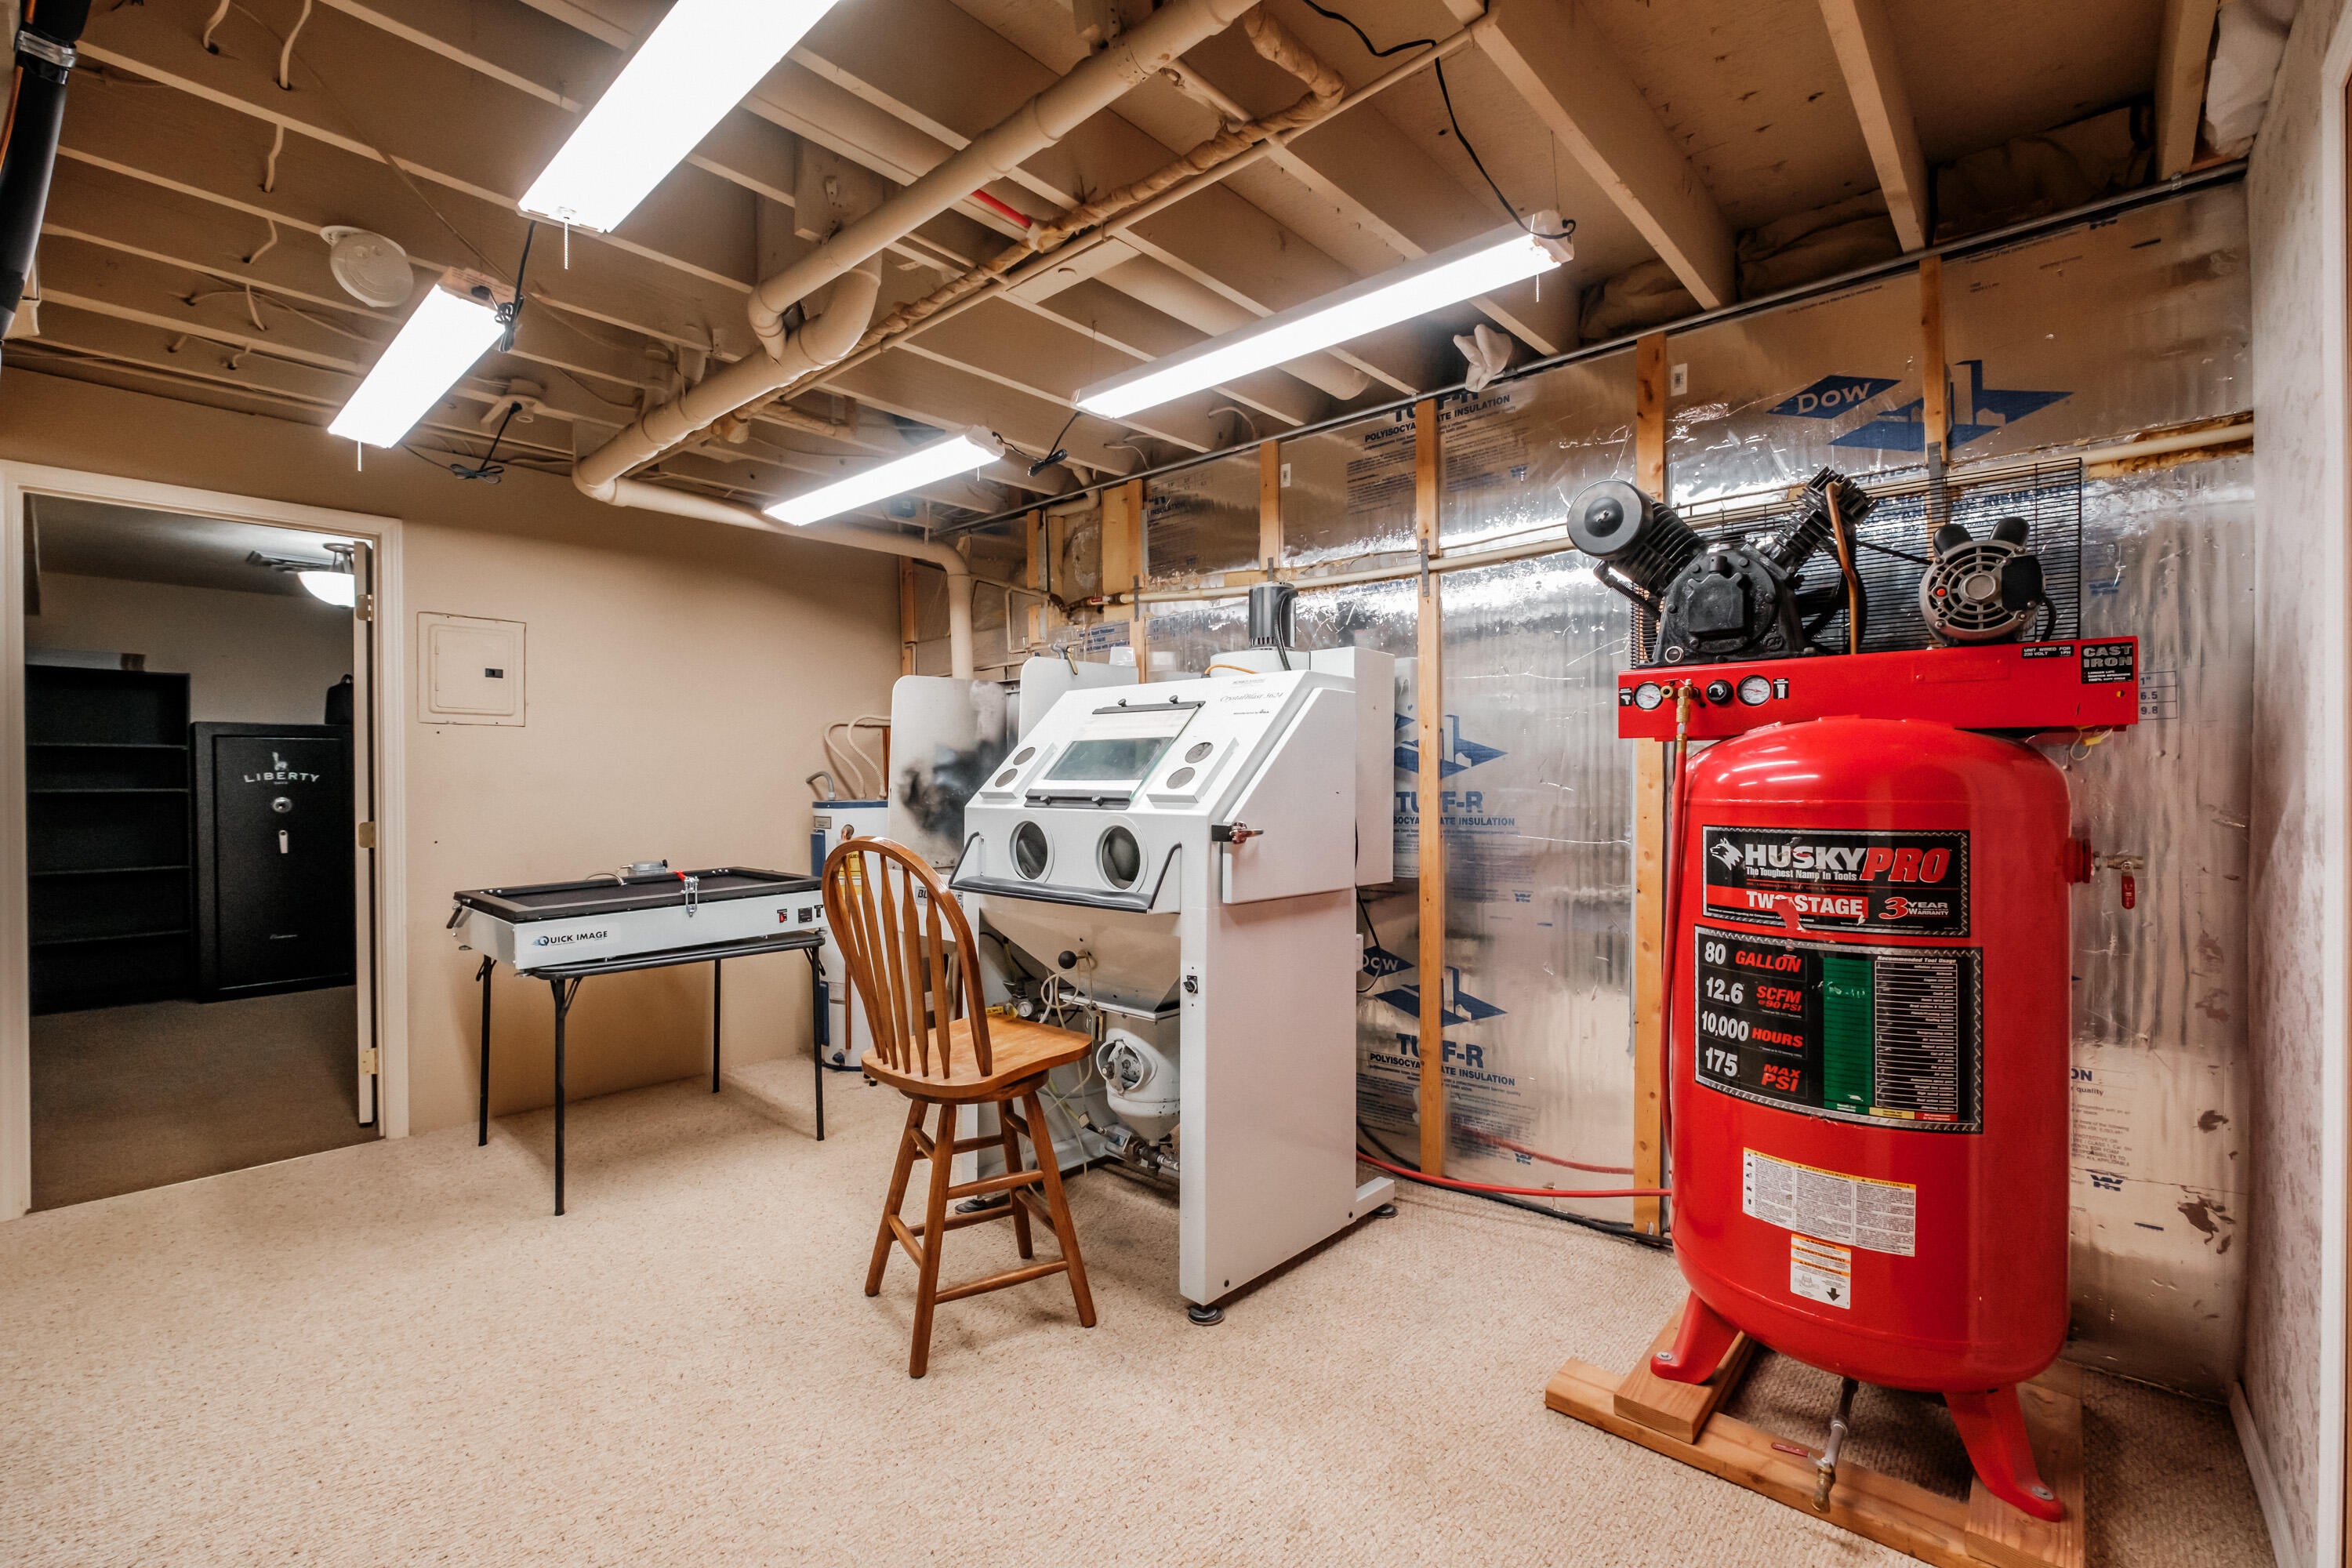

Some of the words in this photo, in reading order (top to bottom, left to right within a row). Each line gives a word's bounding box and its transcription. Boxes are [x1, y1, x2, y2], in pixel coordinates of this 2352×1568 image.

[1795, 383, 1871, 415] DOW
[1364, 412, 1451, 442] POLYISOCYAATE
[1454, 394, 1510, 417] INSULATION
[2083, 645, 2132, 657] CAST
[2083, 656, 2132, 667] IRON
[2140, 691, 2158, 700] 6.5
[2140, 706, 2158, 714] 9.8
[244, 771, 320, 782] LIBERTY
[1396, 790, 1484, 813] TUF-R
[1459, 817, 1515, 826] INSULATION
[1746, 866, 1759, 876] The
[1759, 867, 1793, 878] Toughest
[1795, 869, 1819, 879] Name
[1822, 871, 1831, 880] In
[1833, 871, 1857, 881] Tools
[1746, 891, 1790, 909] TW
[1794, 895, 1863, 915] STAGE
[1878, 896, 1908, 920] 3
[538, 935, 573, 946] QUICK
[576, 931, 608, 940] IMAGE
[1704, 941, 1726, 965] 80
[1735, 950, 1802, 973] GALLON
[1706, 977, 1744, 1004] 12.6
[1756, 985, 1802, 1004] SCFM
[1782, 1004, 1802, 1012] PSI
[1701, 1011, 1749, 1042] 10,000
[1751, 1027, 1803, 1047] HOURS
[1396, 1033, 1484, 1069] TUF-R
[1370, 1053, 1456, 1076] POLYISOCYAATE
[1459, 1069, 1515, 1086] INSULATION
[1705, 1047, 1738, 1077] 175
[1764, 1064, 1801, 1078] MAX
[1761, 1073, 1799, 1091] PSI
[2076, 1087, 2103, 1096] quality
